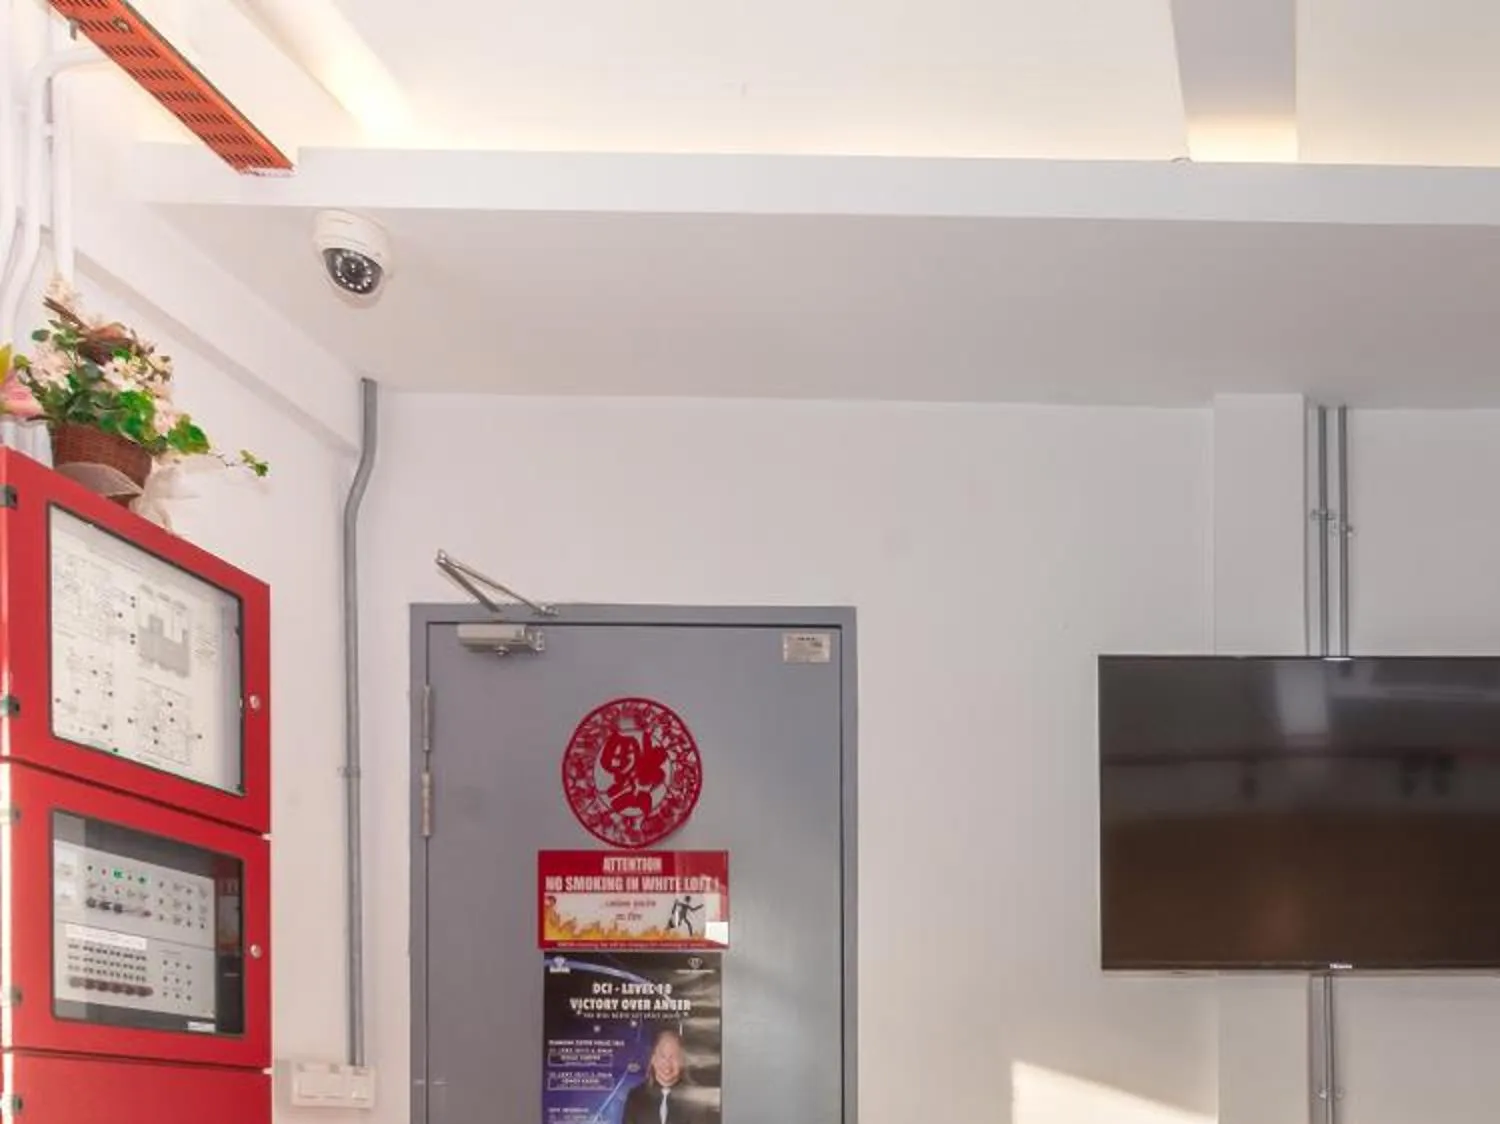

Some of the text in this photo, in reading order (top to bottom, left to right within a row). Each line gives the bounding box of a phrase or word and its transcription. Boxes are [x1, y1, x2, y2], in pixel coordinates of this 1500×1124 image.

[602, 856, 663, 872] ATTENTION
[545, 875, 563, 891] NO
[565, 875, 625, 892] SMOKING
[642, 876, 681, 892] WHITE
[620, 998, 651, 1011] OVER
